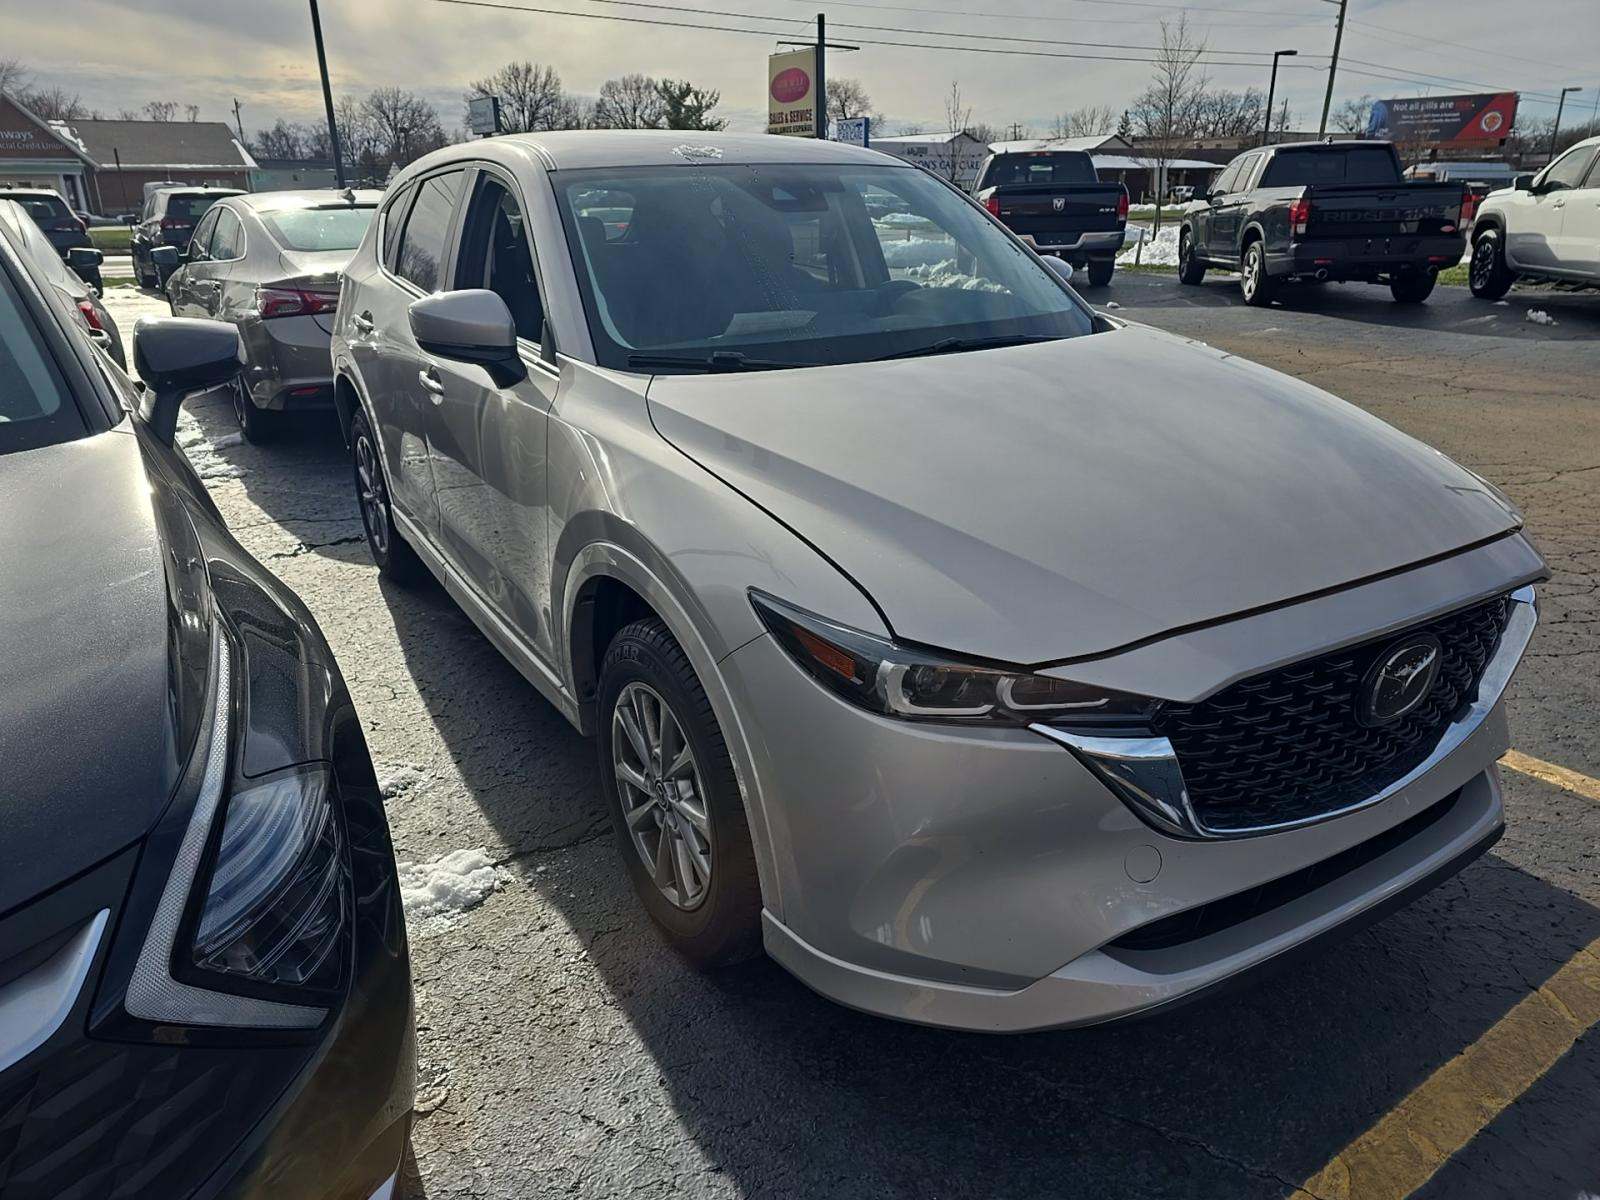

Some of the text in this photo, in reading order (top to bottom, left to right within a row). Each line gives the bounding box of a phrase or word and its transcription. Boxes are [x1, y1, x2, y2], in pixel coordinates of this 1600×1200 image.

[1393, 103, 1408, 112] Not
[1409, 101, 1420, 111] all
[1439, 101, 1454, 109] are
[790, 109, 812, 123] SERVICE
